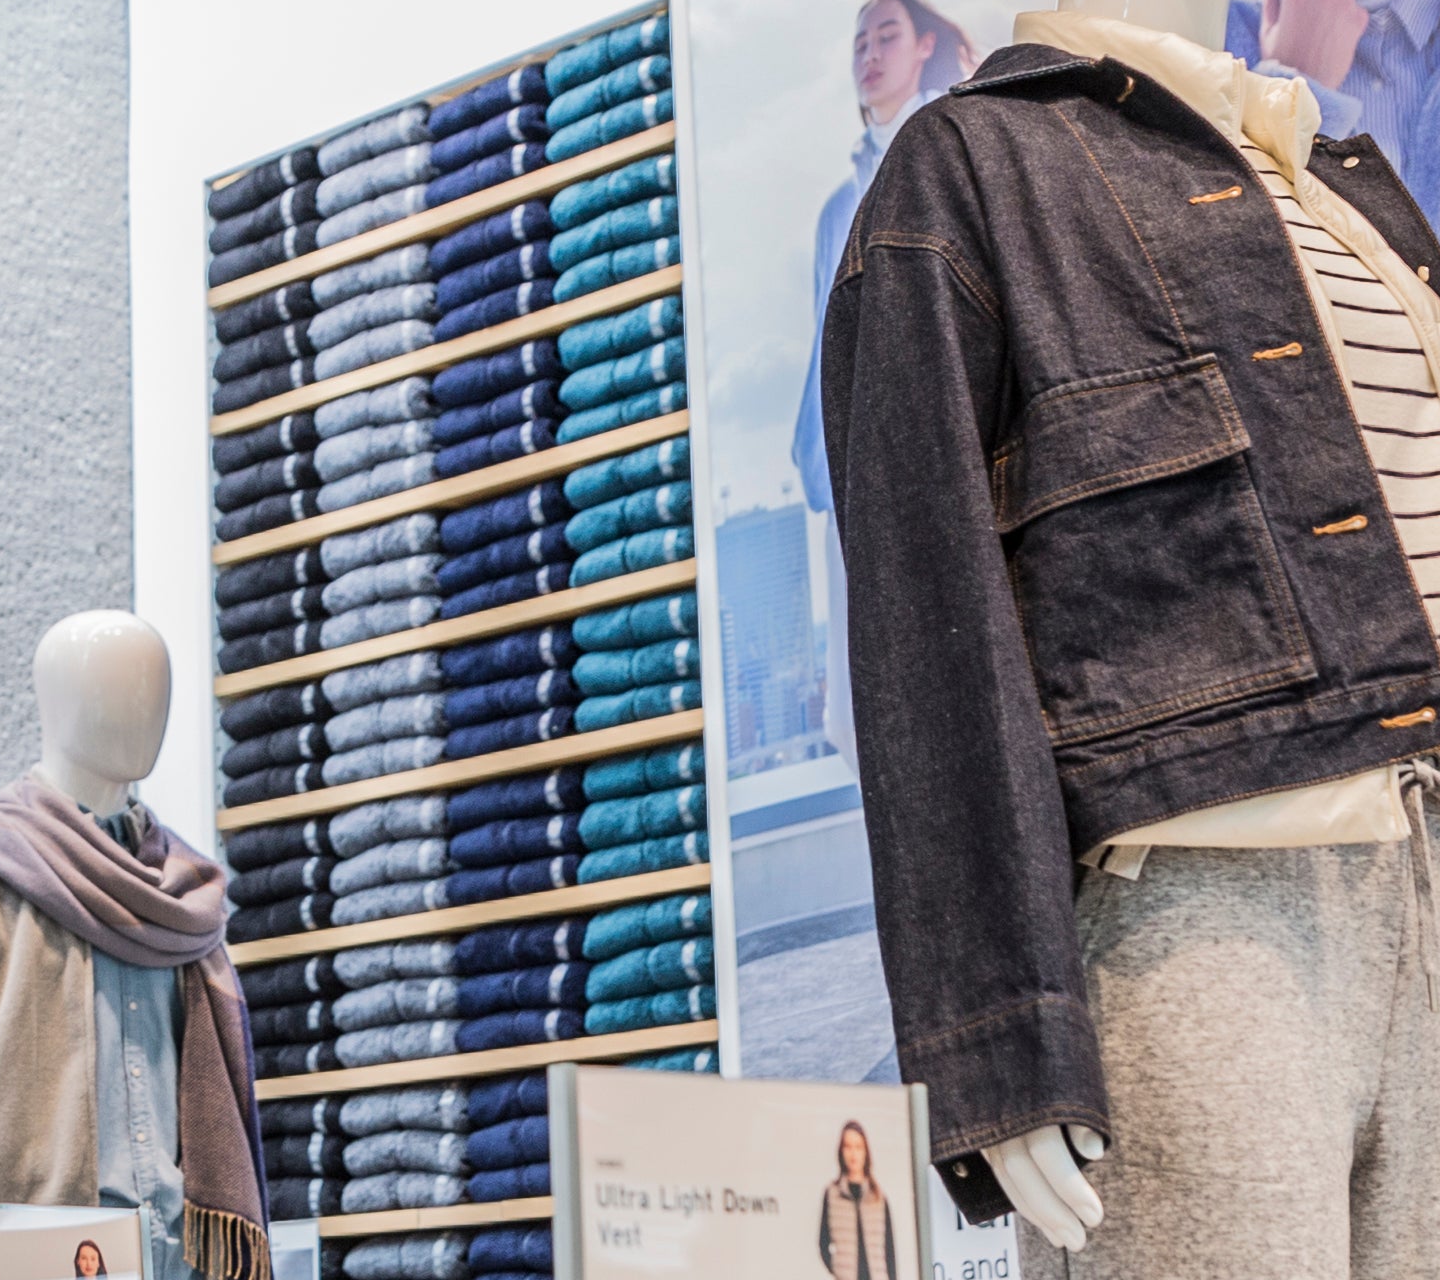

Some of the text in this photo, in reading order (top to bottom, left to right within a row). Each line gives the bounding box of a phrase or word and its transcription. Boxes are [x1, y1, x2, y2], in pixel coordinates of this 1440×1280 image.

[596, 1183, 780, 1218] Ultra Light Down
[599, 1221, 642, 1247] Vest
[962, 1249, 1009, 1280] and
